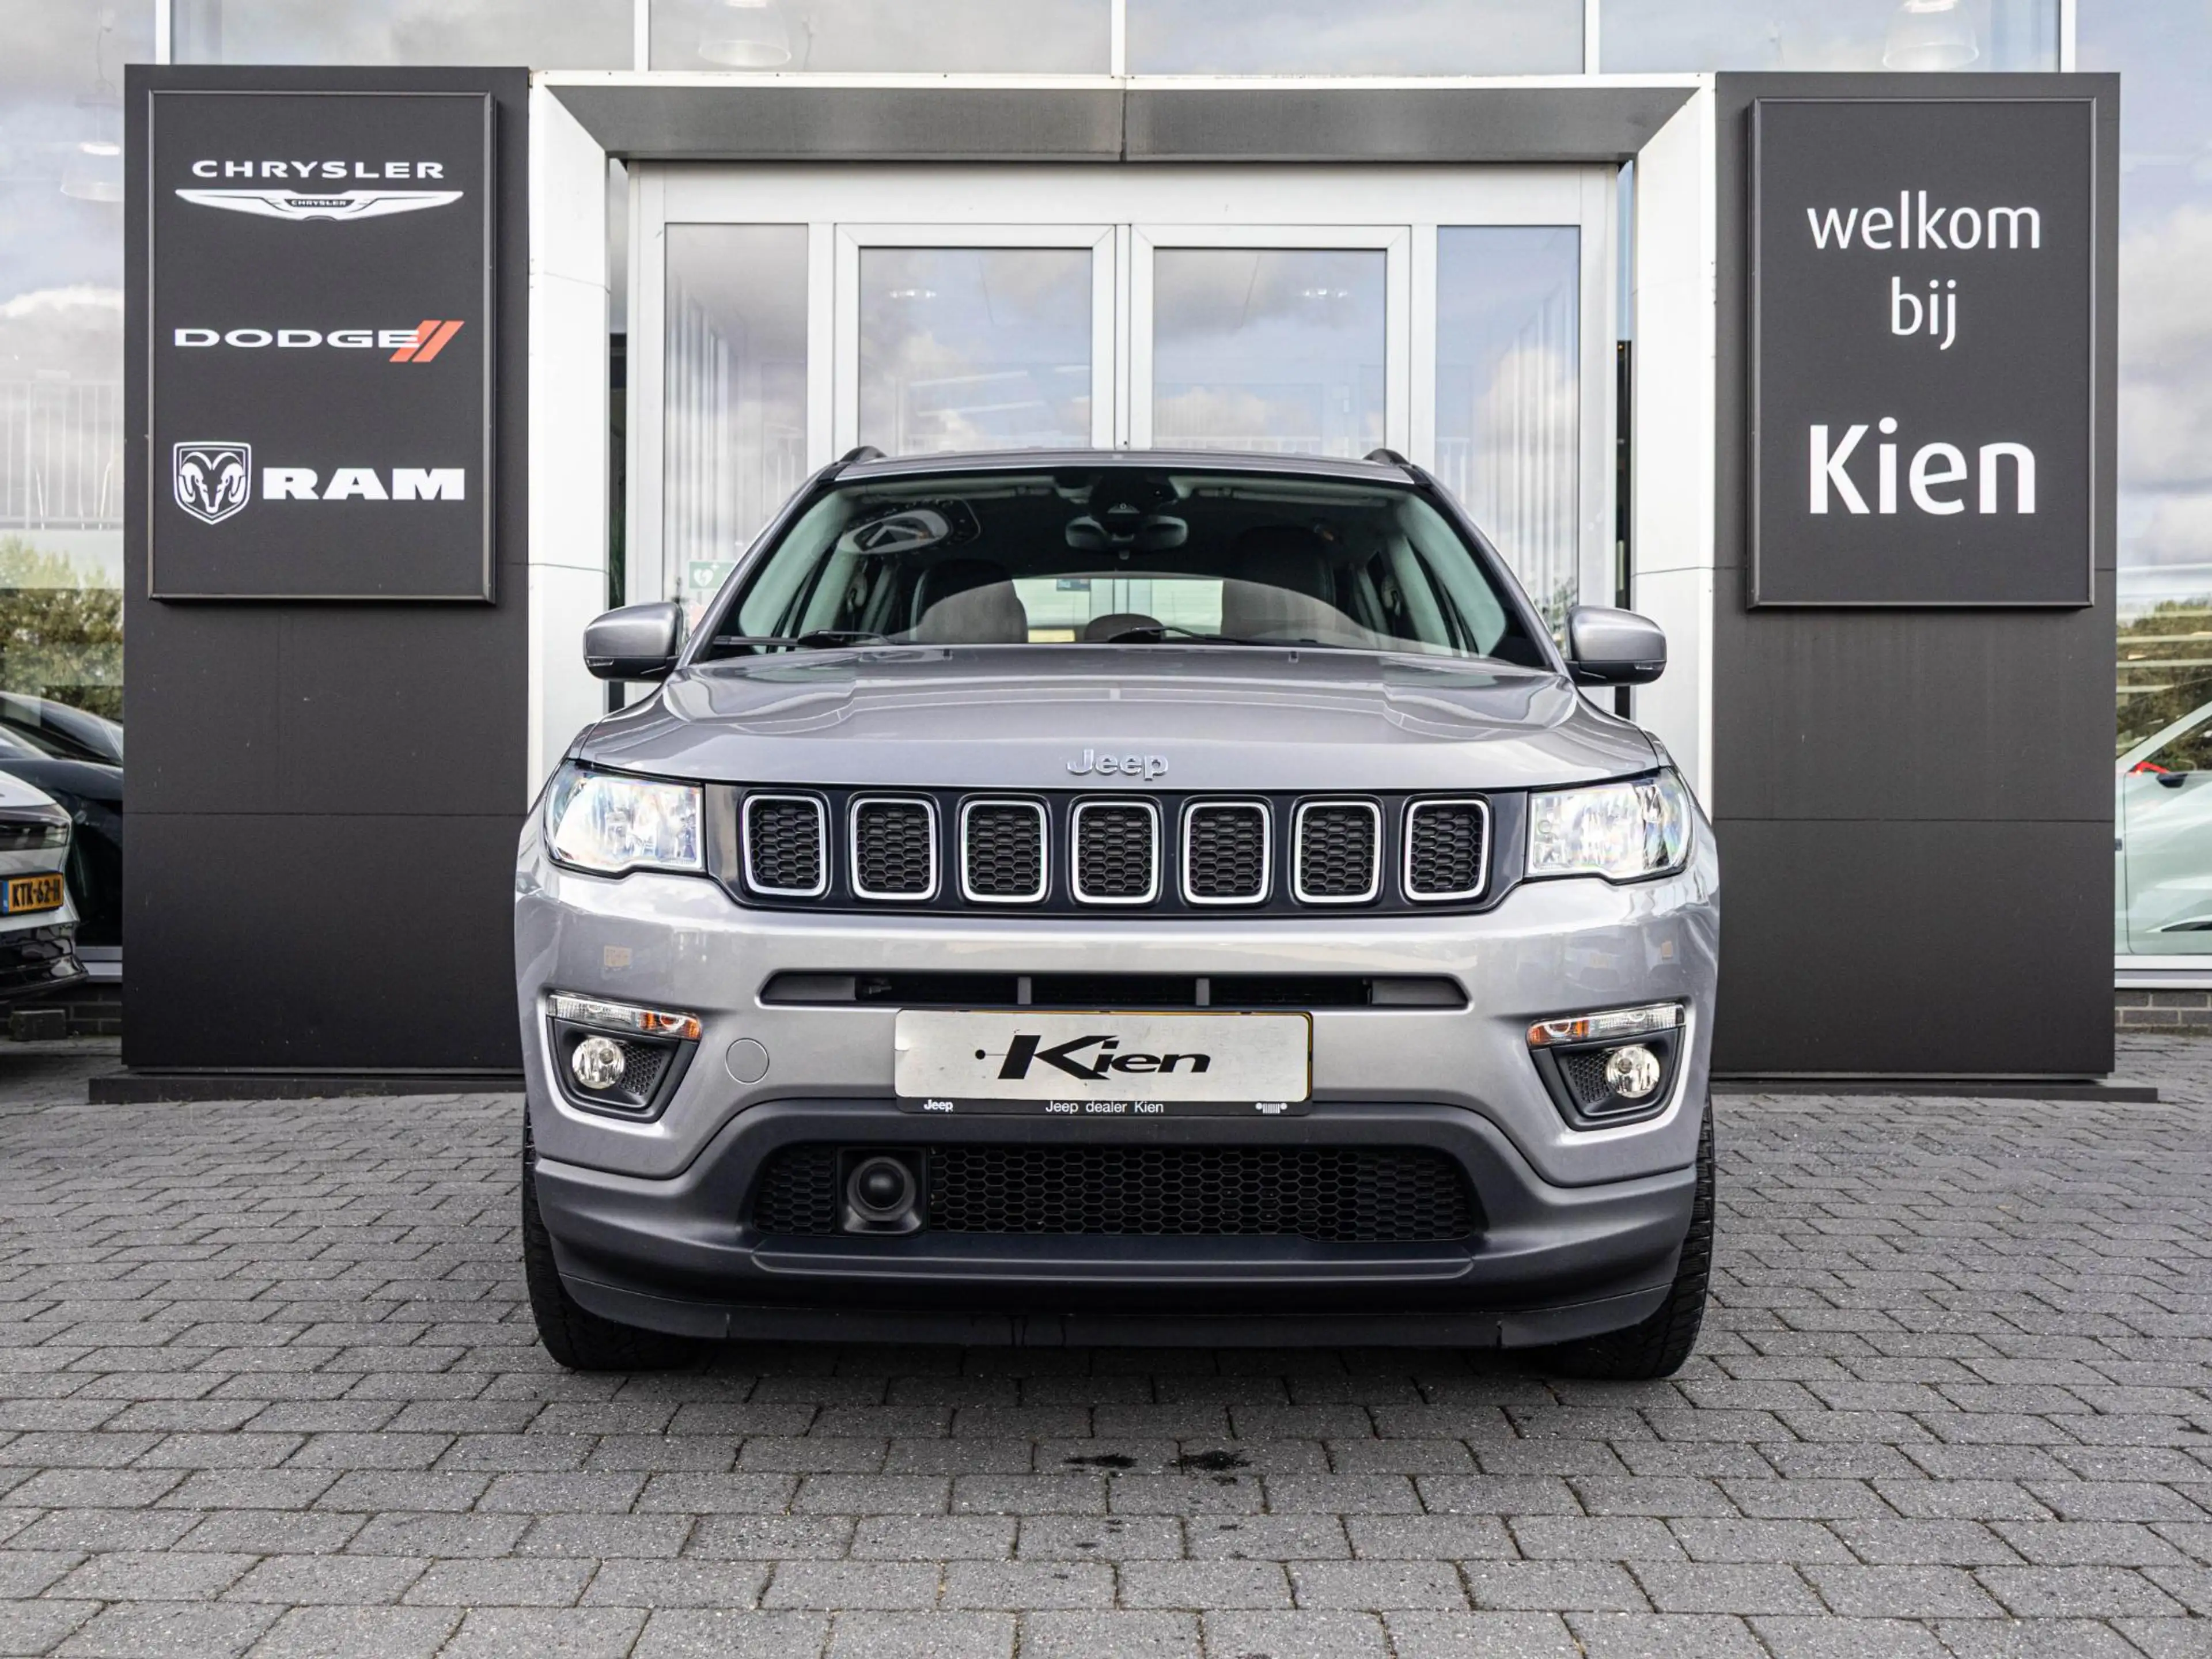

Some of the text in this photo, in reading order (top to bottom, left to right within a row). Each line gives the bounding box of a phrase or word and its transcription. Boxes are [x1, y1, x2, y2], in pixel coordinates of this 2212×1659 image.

[192, 160, 444, 179] CHRYSLER
[1806, 190, 2040, 249] welkom
[1892, 276, 1956, 350] bij
[175, 328, 420, 349] DODGE
[1810, 416, 2036, 515] Kien
[263, 467, 465, 500] RAM
[1067, 749, 1168, 781] Jeep
[998, 1035, 1211, 1080] Kien
[923, 1099, 954, 1112] Jeep
[1046, 1101, 1164, 1115] Jeep dealer Kien
